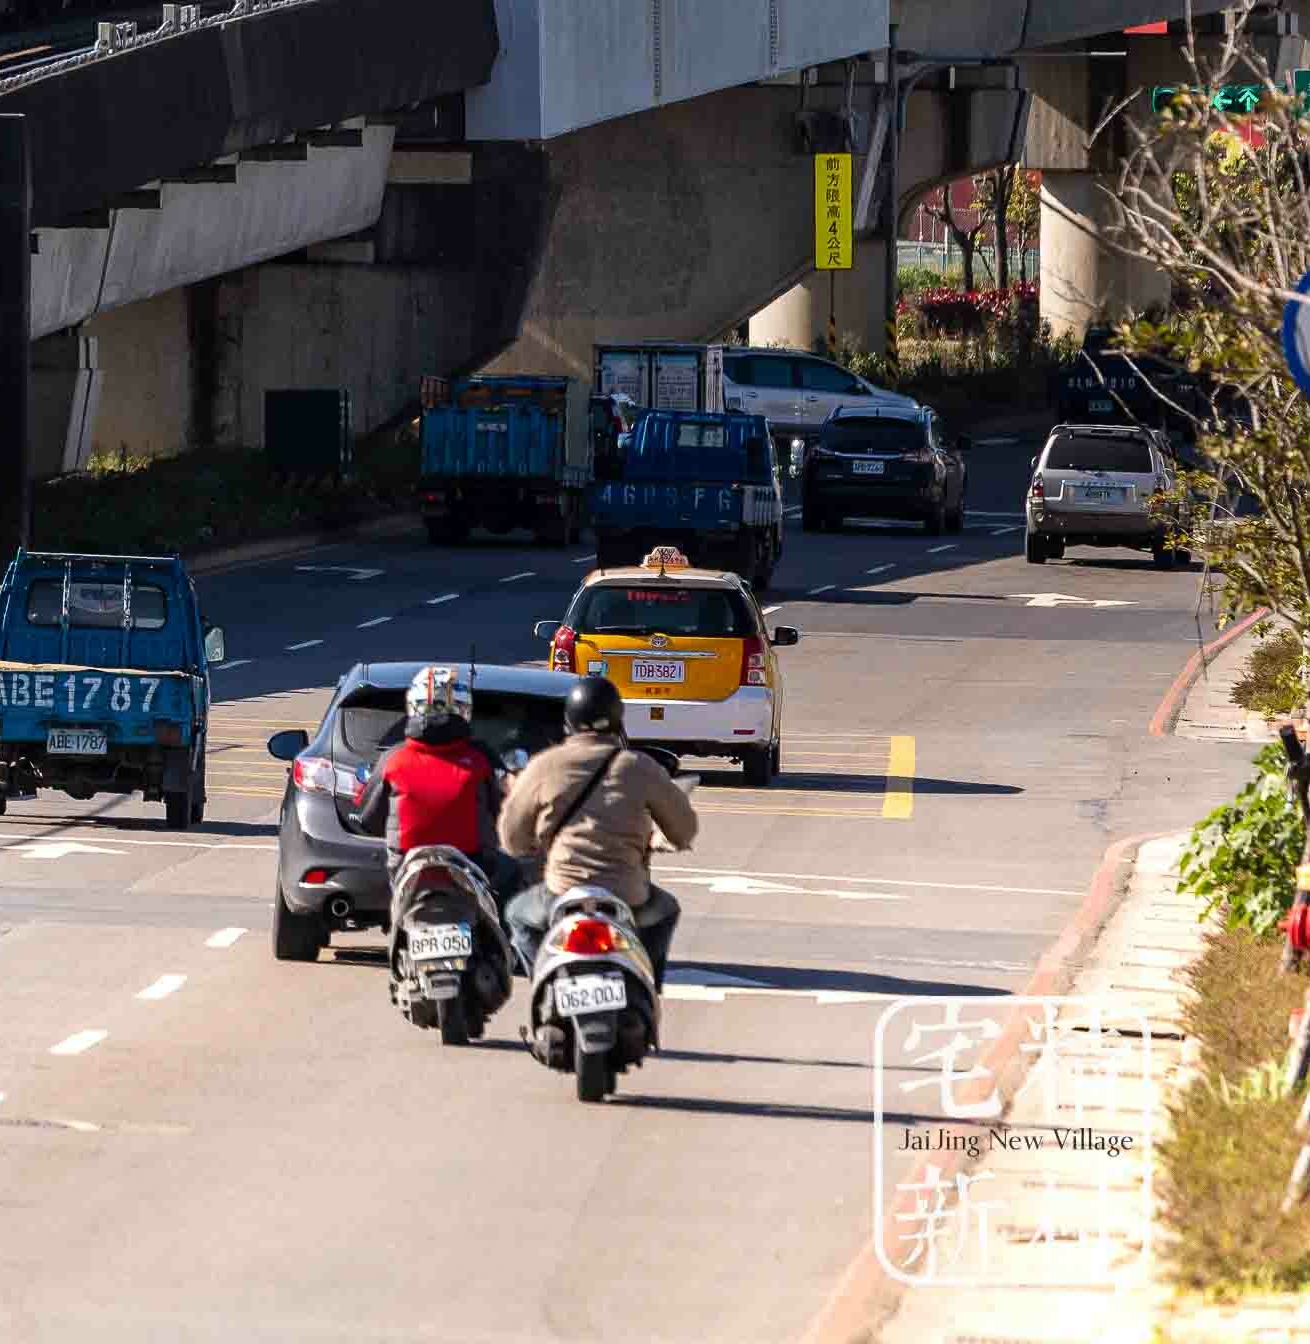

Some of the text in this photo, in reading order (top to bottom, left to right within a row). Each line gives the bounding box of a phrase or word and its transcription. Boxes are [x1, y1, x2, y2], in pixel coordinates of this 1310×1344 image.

[825, 157, 842, 266] 前方限高4公尺
